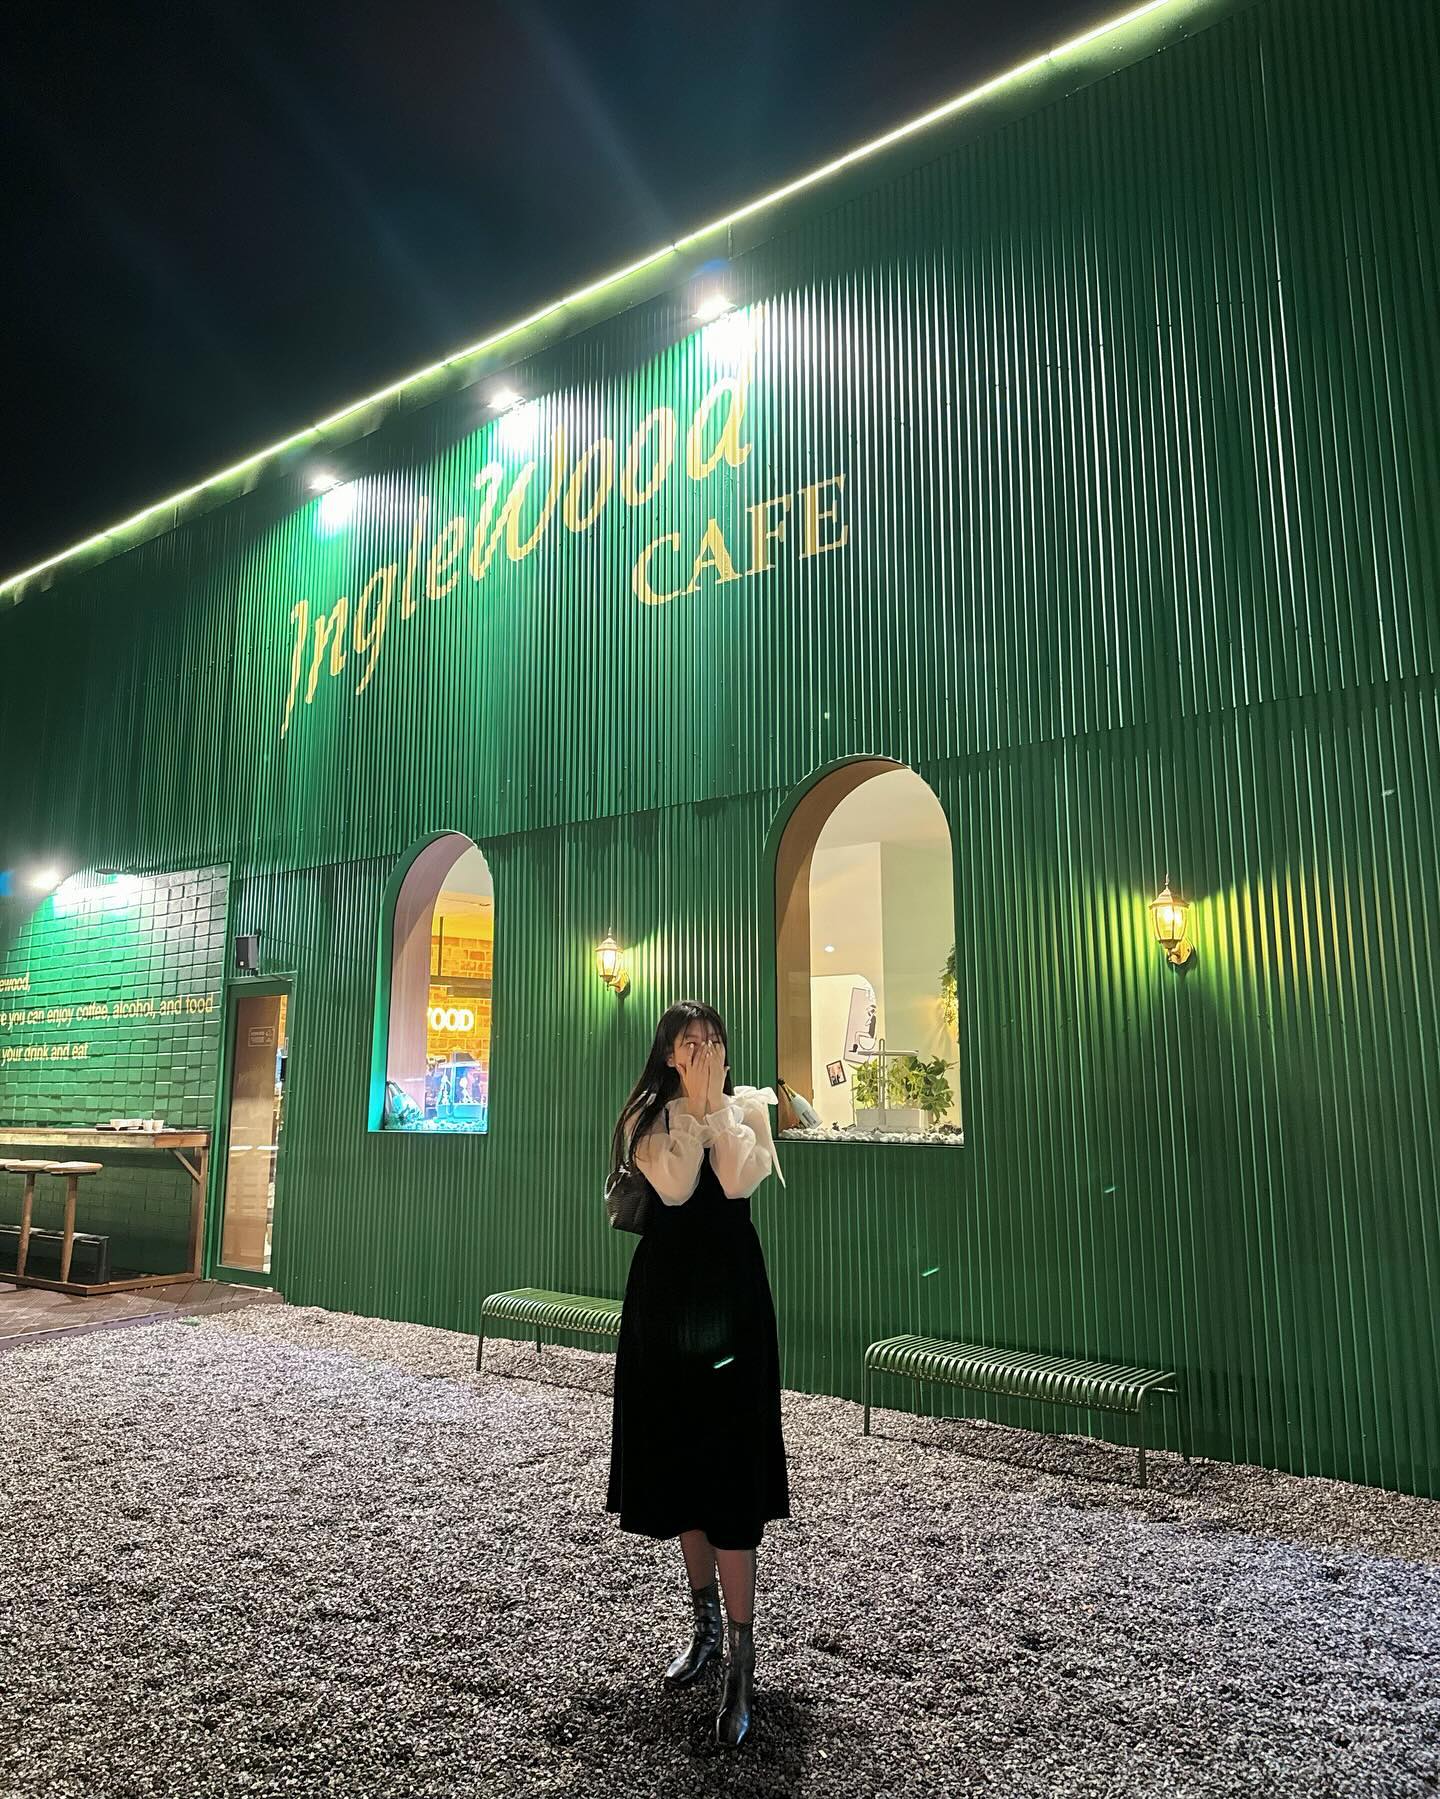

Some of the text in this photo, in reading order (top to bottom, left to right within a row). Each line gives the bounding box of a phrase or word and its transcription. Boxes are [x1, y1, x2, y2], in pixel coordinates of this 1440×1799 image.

[632, 473, 848, 606] CAFE
[8, 1012, 25, 1030] you
[27, 1009, 44, 1024] can
[47, 1006, 74, 1027] enjoy
[76, 1002, 110, 1022] coffee,
[112, 997, 156, 1019] alcohol,
[160, 996, 182, 1016] and
[186, 993, 214, 1014] food
[427, 1007, 474, 1031] OOD
[1, 1047, 23, 1066] your
[24, 1042, 48, 1061] drink
[50, 1041, 70, 1060] and
